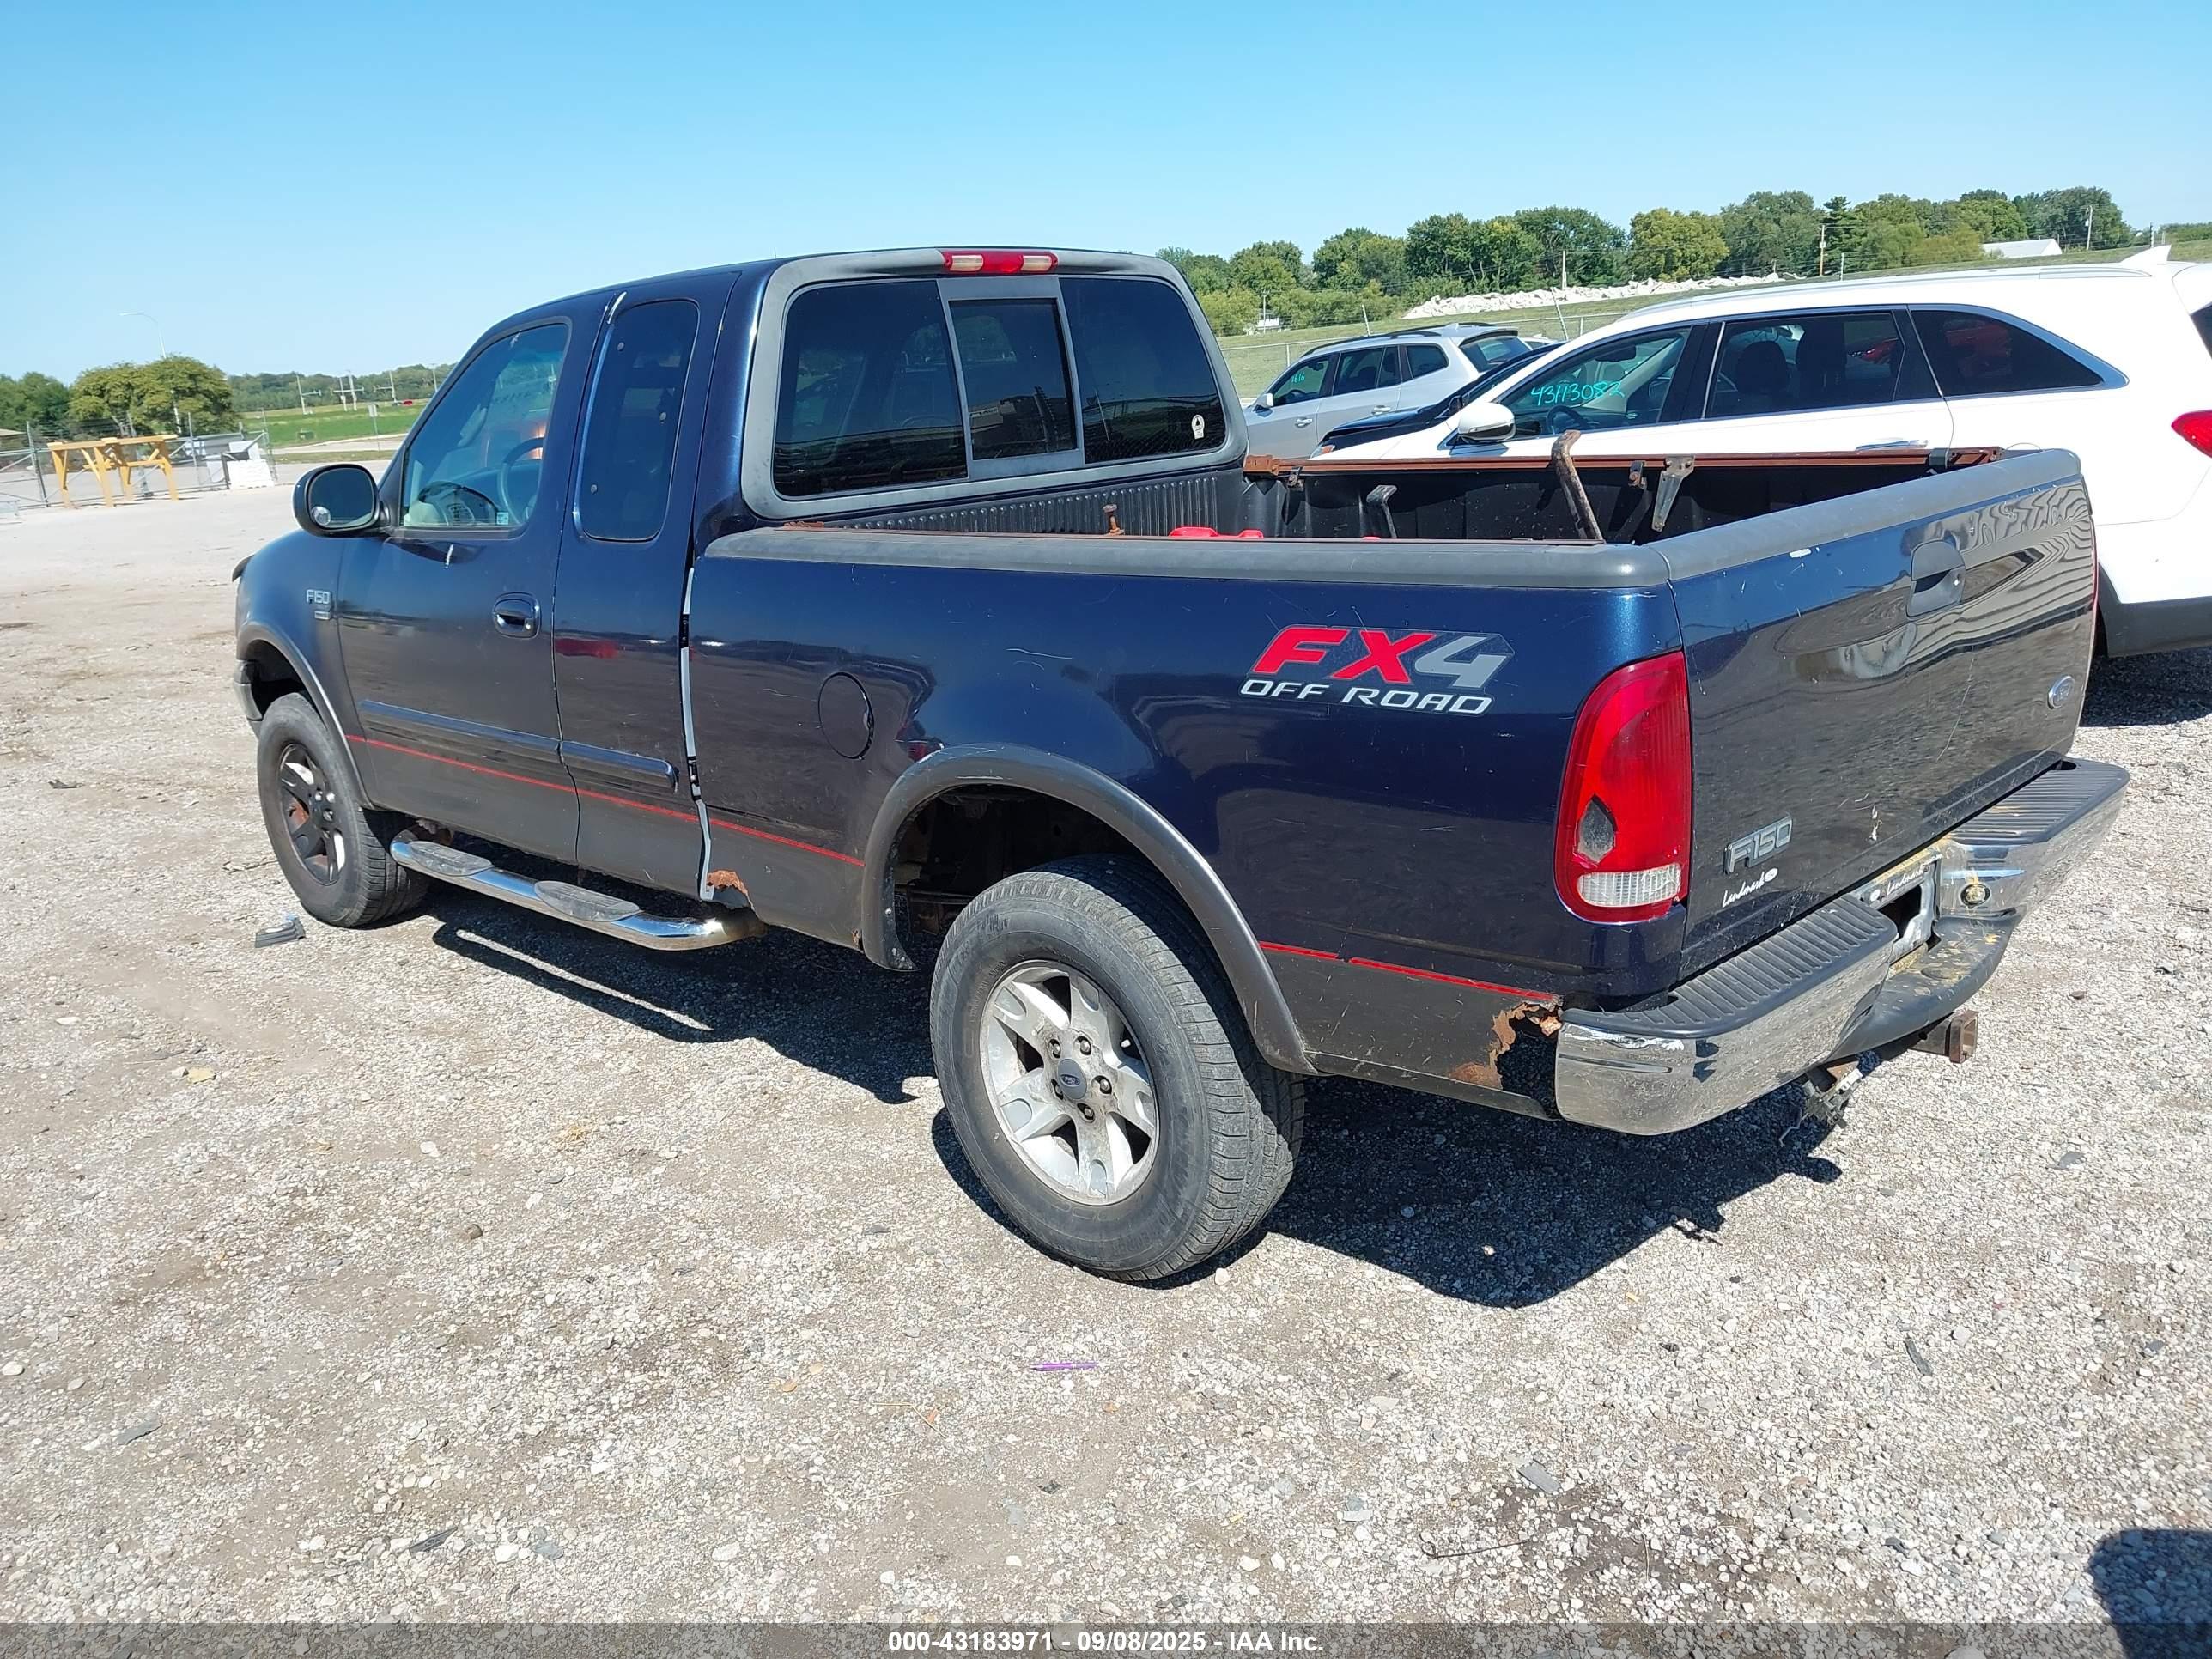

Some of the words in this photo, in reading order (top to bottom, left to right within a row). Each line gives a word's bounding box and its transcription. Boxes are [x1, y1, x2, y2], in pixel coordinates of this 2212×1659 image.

[1531, 380, 1625, 405] 43113082
[1252, 625, 1508, 689] FX4
[1240, 679, 1330, 699] OFF
[1341, 687, 1493, 714] ROAD
